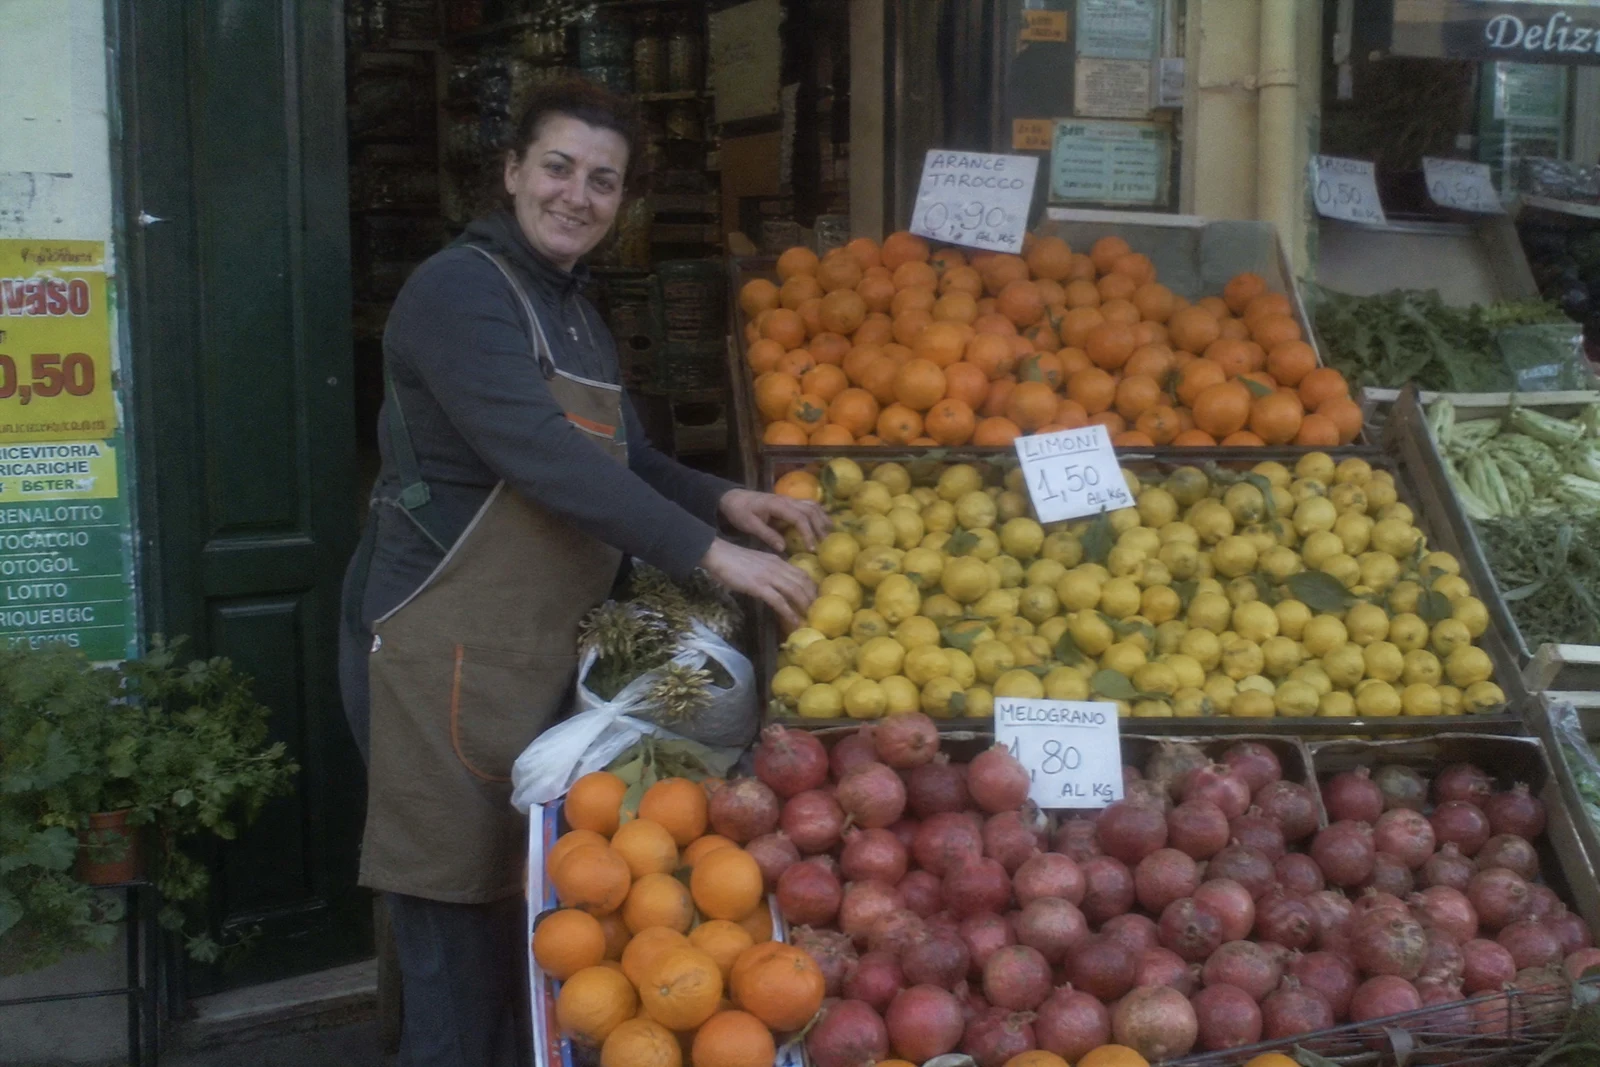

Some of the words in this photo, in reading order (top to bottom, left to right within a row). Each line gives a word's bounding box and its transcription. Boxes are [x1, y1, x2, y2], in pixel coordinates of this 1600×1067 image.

[930, 154, 1005, 171] ARANCE
[928, 173, 1024, 189] TAROCCO
[923, 201, 1006, 236] 0,90
[0, 279, 90, 316] vaso
[0, 445, 100, 459] ICEVITORIA
[1037, 464, 1100, 502] 1,50
[7, 583, 68, 600] LOTTO
[1000, 704, 1106, 725] MELOGRANO
[1061, 783, 1085, 797] AL
